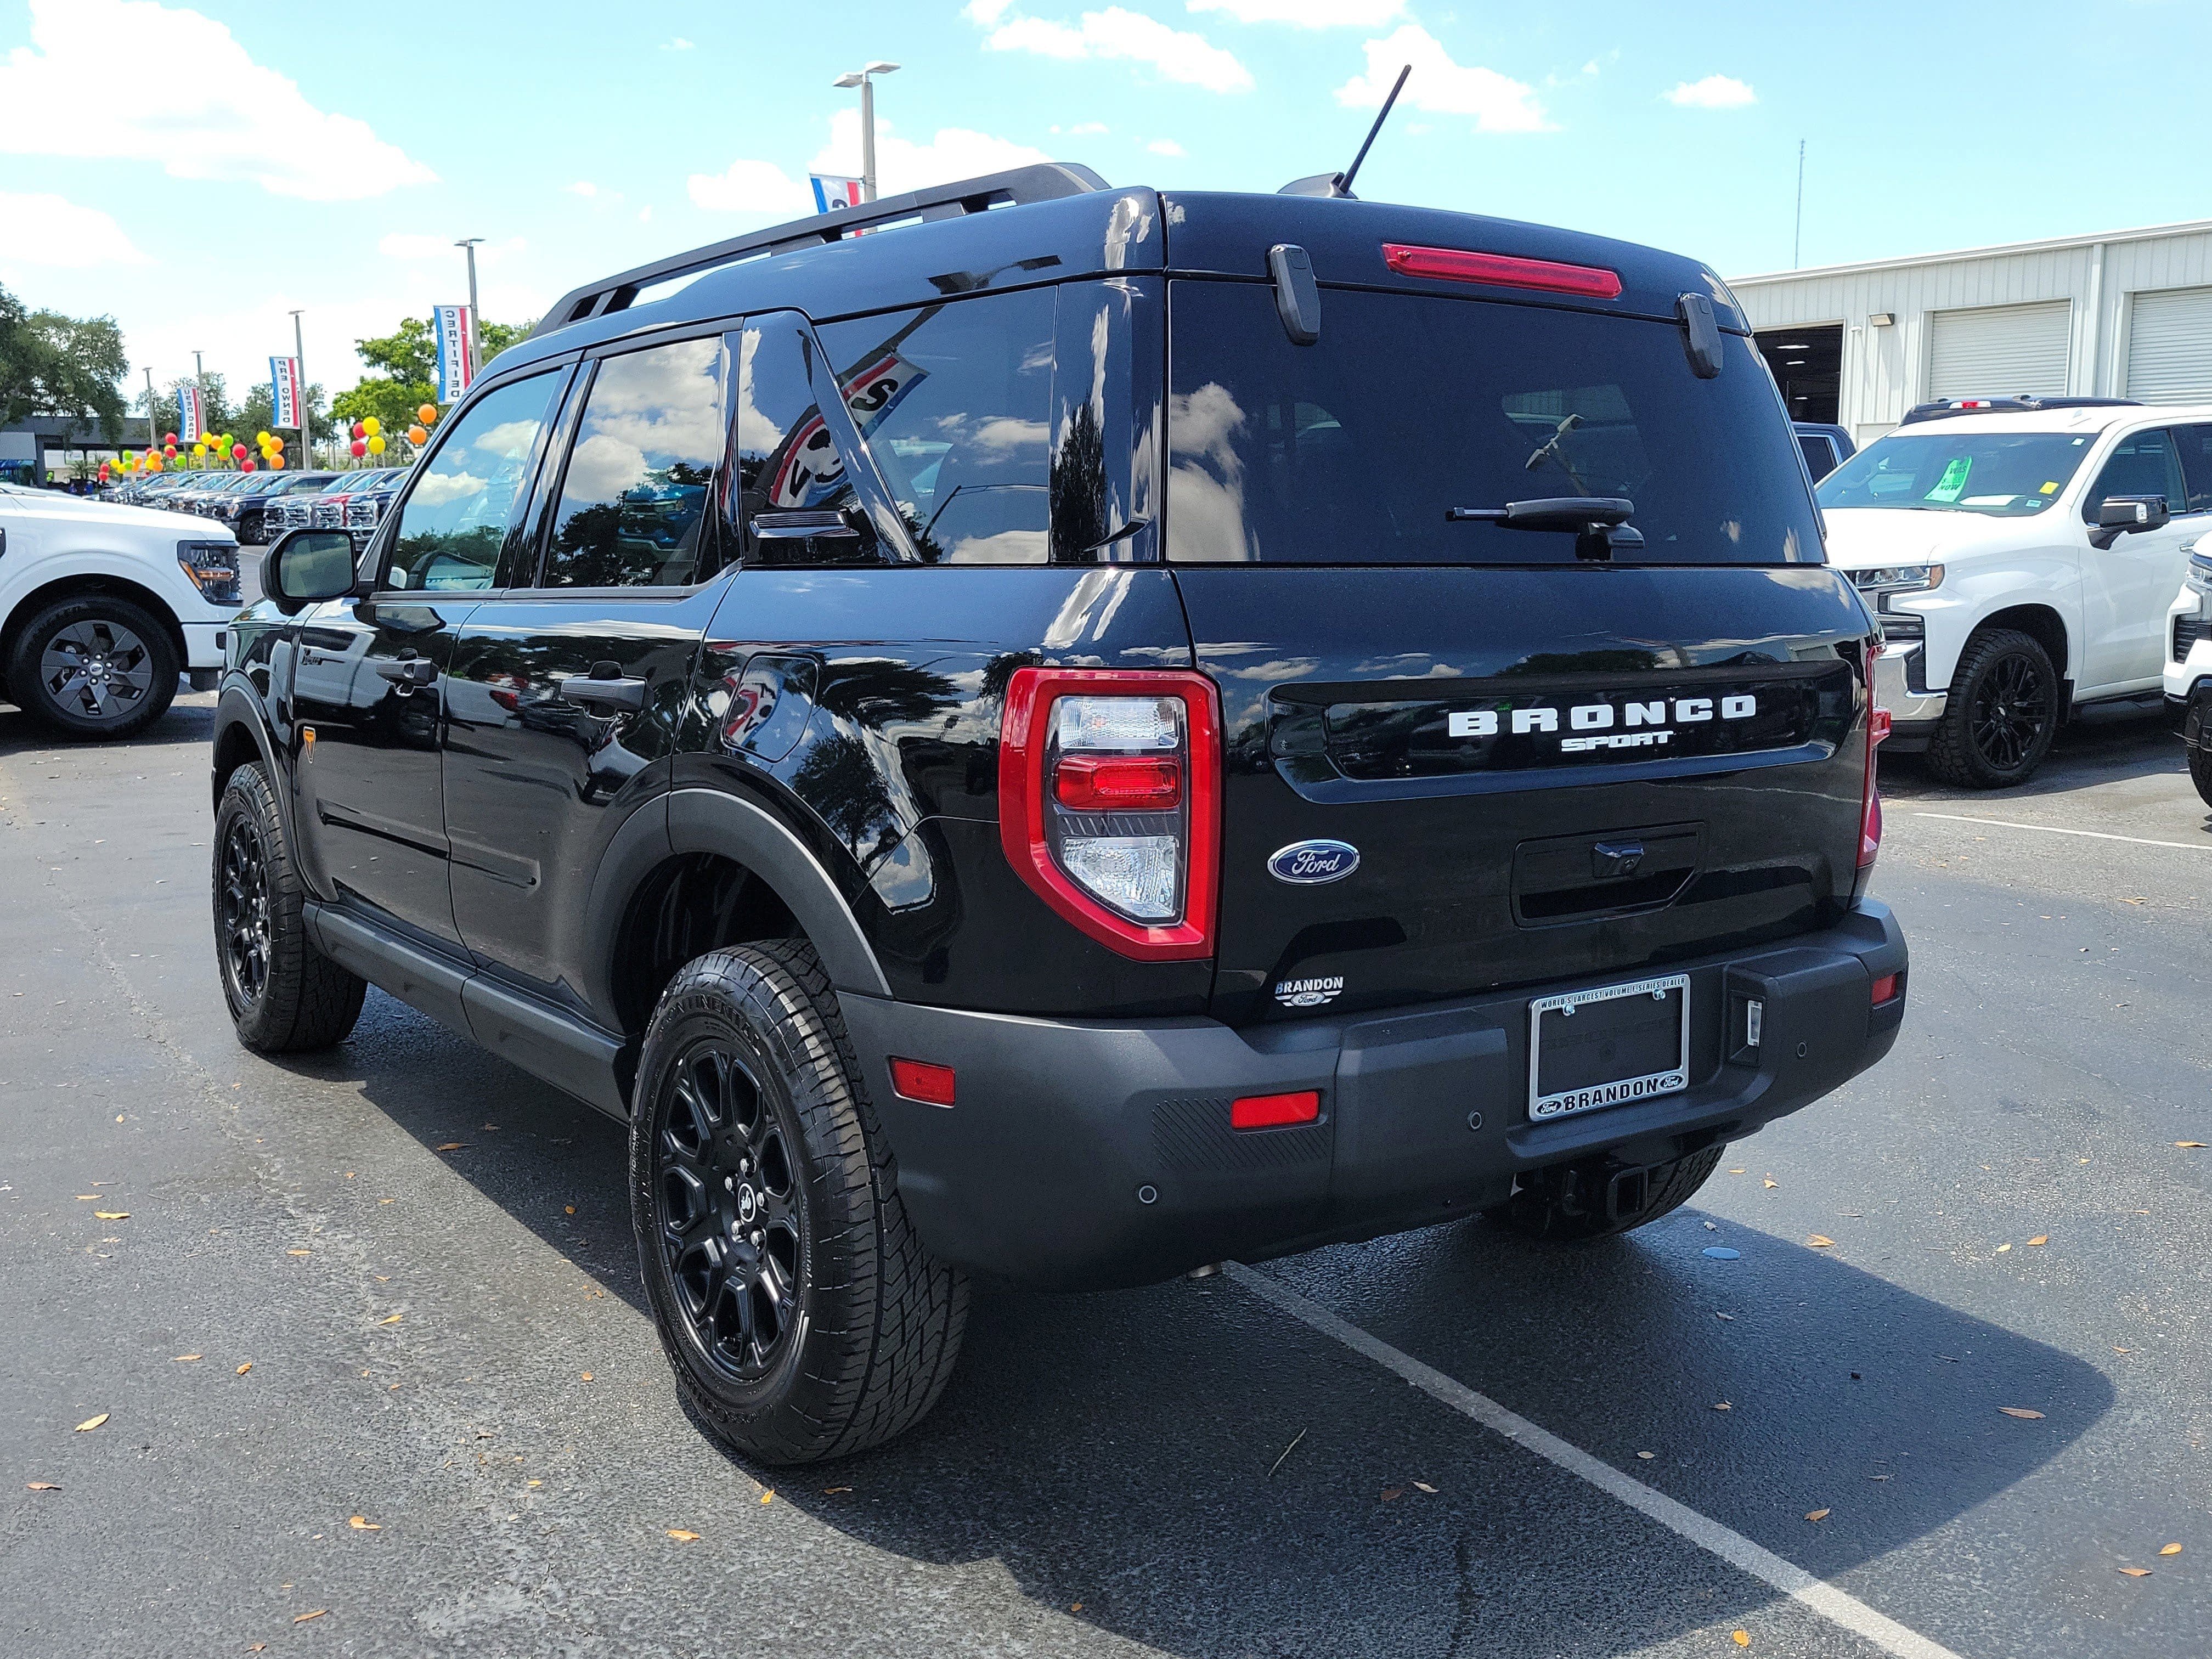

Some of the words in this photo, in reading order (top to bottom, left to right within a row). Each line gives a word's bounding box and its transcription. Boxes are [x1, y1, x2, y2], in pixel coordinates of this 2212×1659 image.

[1448, 695, 1756, 737] BRONCO
[1561, 730, 1674, 752] SPORT
[1291, 849, 1340, 874] Ford
[1275, 977, 1344, 994] BRANDON
[1573, 991, 1602, 1003] LARGEST
[1605, 988, 1630, 997] VOLUME
[1662, 978, 1685, 988] DEALER
[1298, 994, 1318, 1003] Ford
[1564, 1077, 1658, 1112] BRANDON
